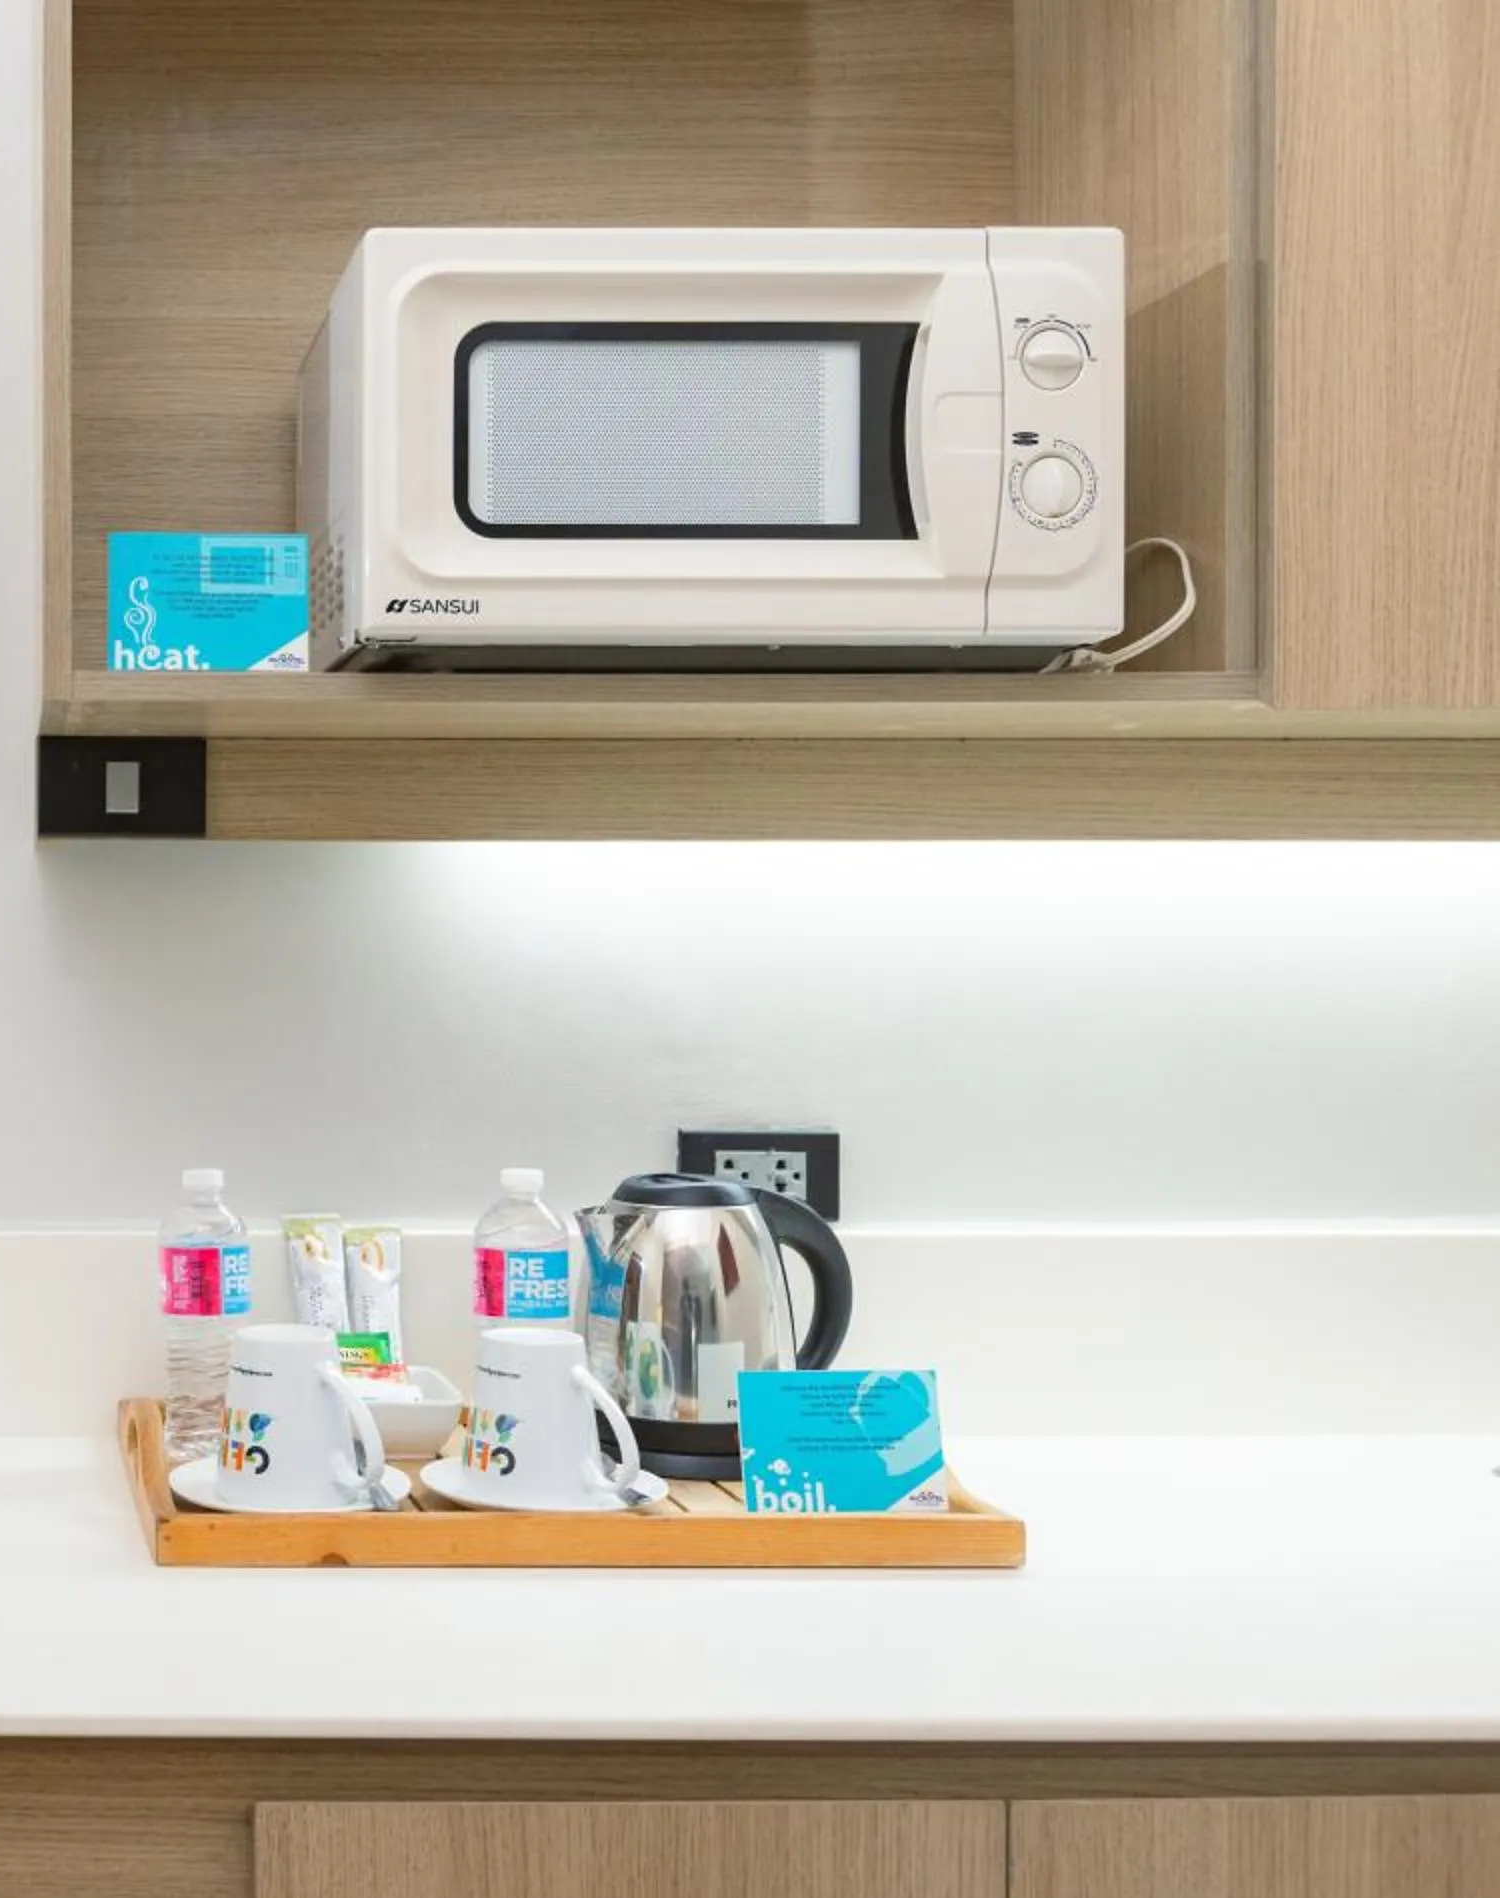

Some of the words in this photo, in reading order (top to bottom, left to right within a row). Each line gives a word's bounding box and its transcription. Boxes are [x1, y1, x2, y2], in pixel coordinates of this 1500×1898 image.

[409, 599, 480, 614] SANSUI
[113, 639, 211, 671] heat.
[509, 1257, 545, 1279] RE
[753, 1476, 837, 1513] boil.
